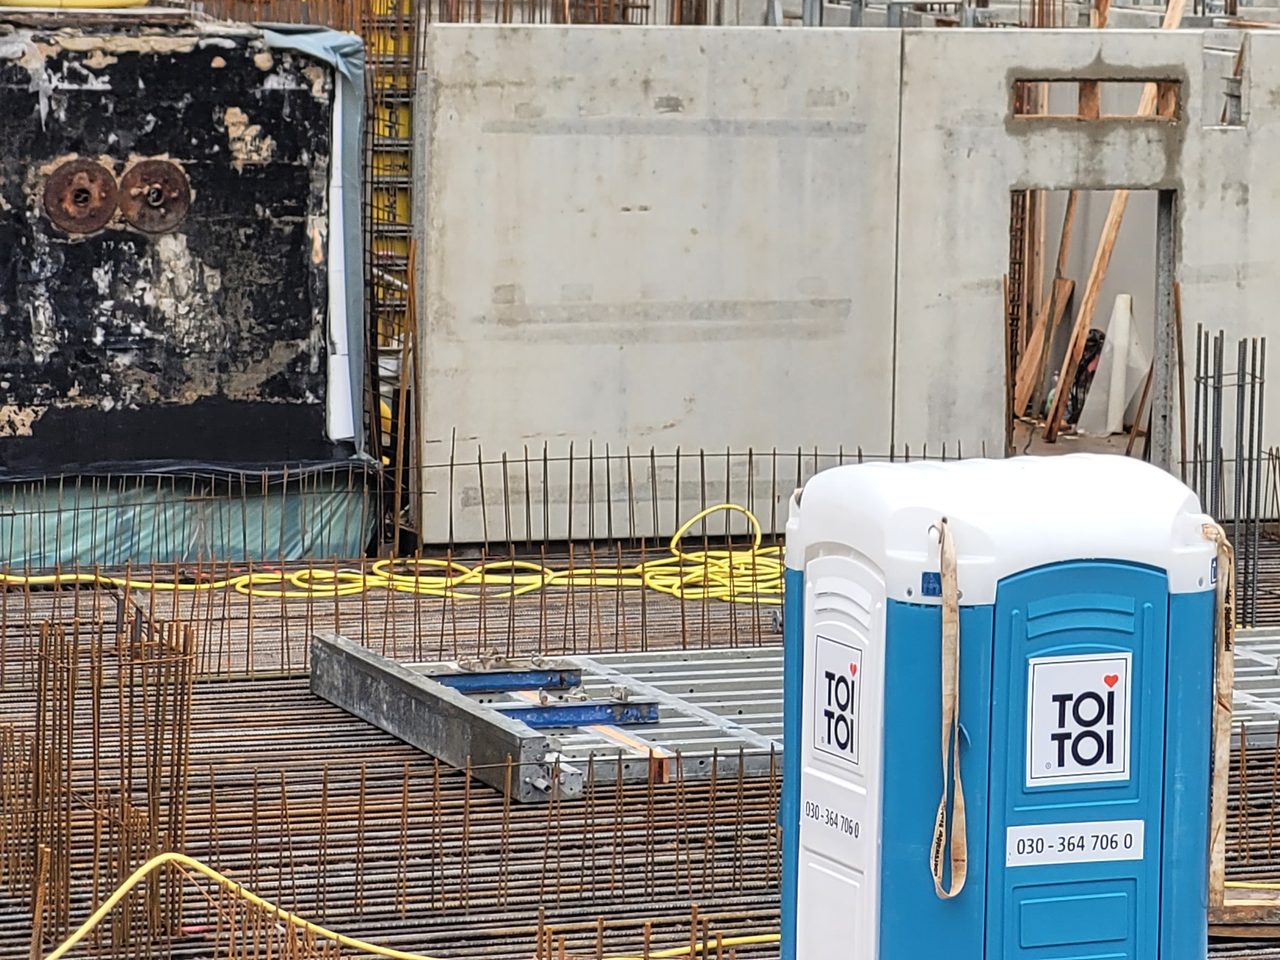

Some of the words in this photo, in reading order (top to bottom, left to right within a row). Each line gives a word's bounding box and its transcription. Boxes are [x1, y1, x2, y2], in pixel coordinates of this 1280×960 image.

[825, 670, 855, 715] TOI
[1052, 691, 1115, 728] TOI
[823, 708, 854, 754] TOI
[1051, 729, 1114, 768] TOI
[805, 800, 820, 820] 030
[825, 808, 838, 829] 364
[840, 814, 854, 836] 706
[1016, 838, 1044, 855] 030
[1057, 835, 1086, 852] 364
[1090, 833, 1119, 851] 706
[1123, 832, 1134, 849] 0
